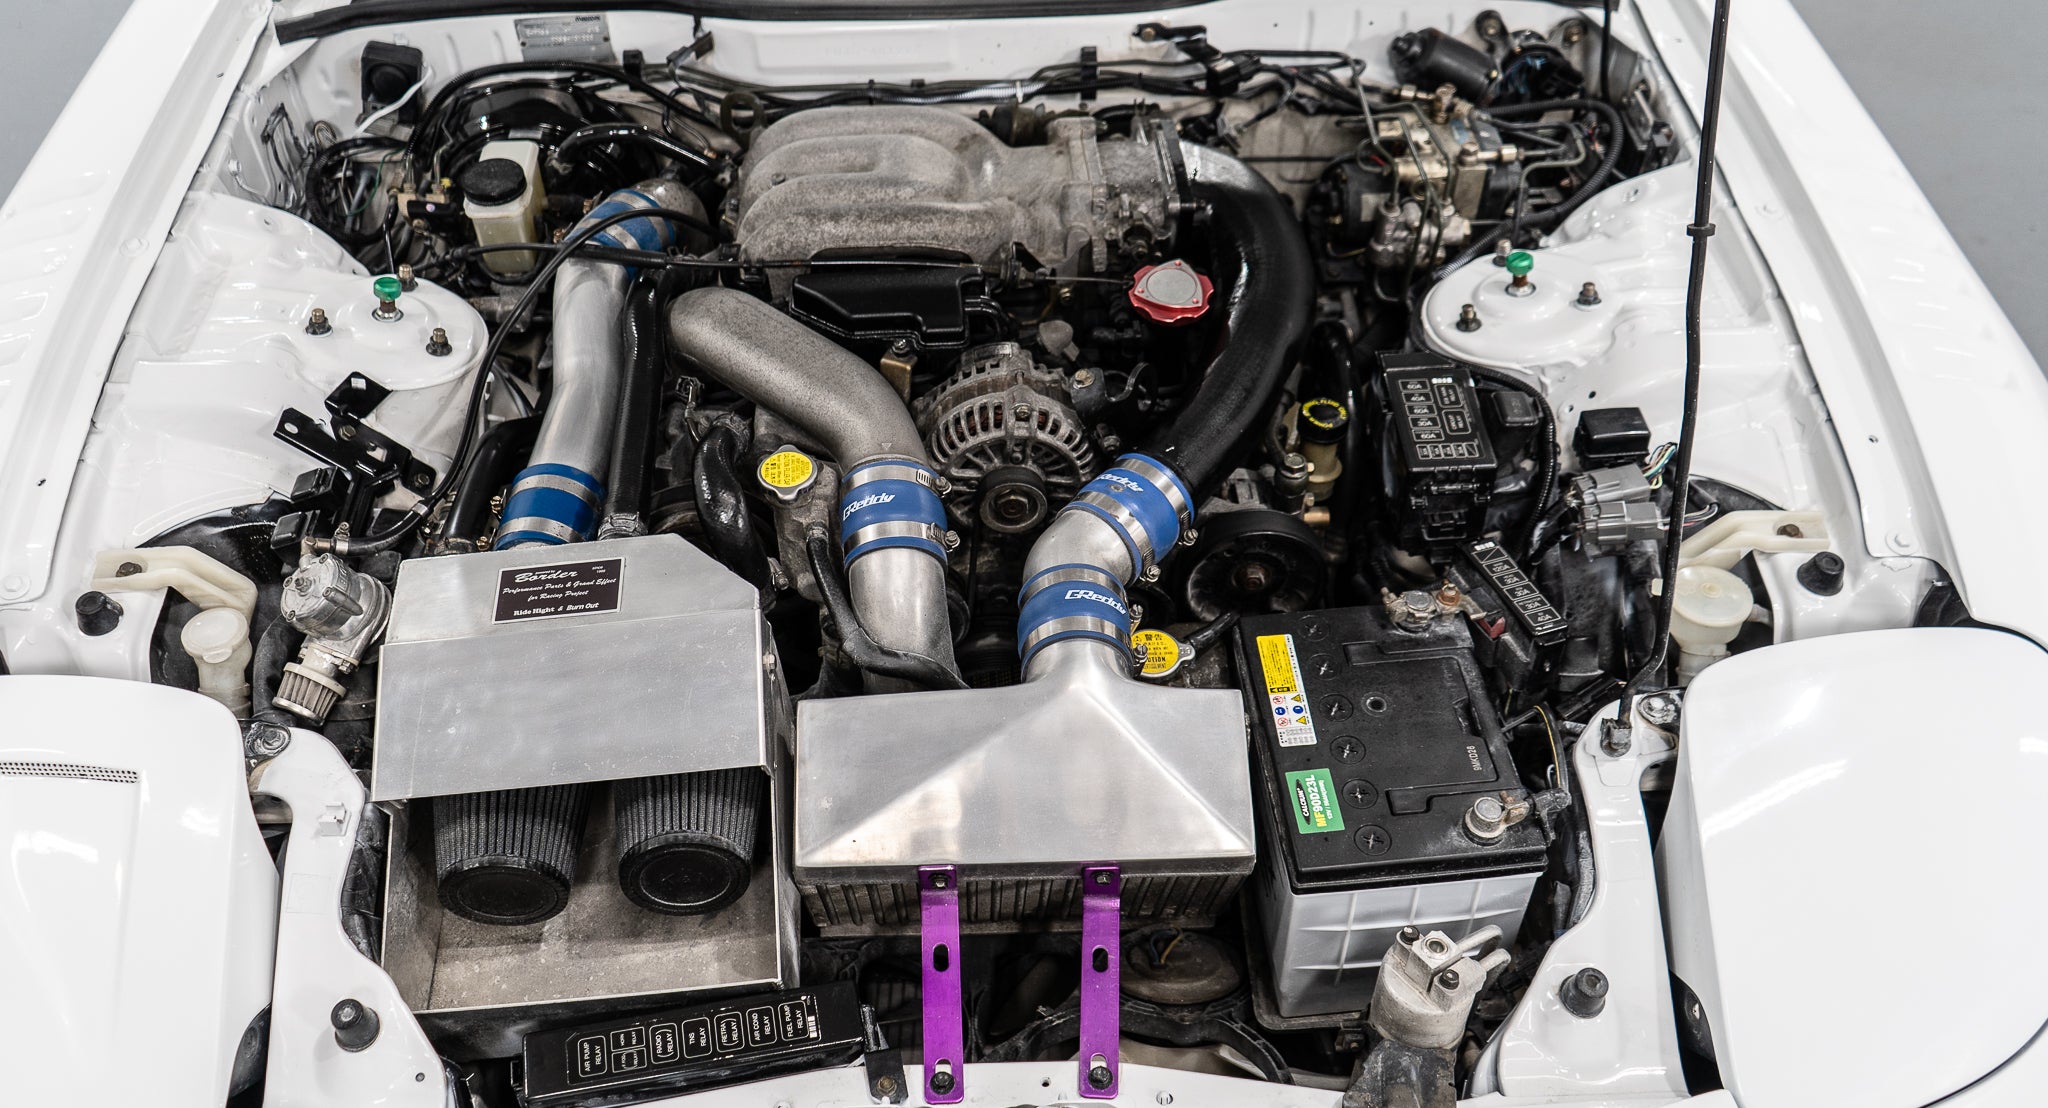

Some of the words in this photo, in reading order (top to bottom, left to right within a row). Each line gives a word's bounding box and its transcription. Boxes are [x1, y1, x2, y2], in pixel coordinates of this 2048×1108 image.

[843, 492, 896, 522] GReddy
[514, 570, 578, 583] Border
[1064, 589, 1127, 615] GReddy
[1305, 774, 1327, 828] MF90D23L
